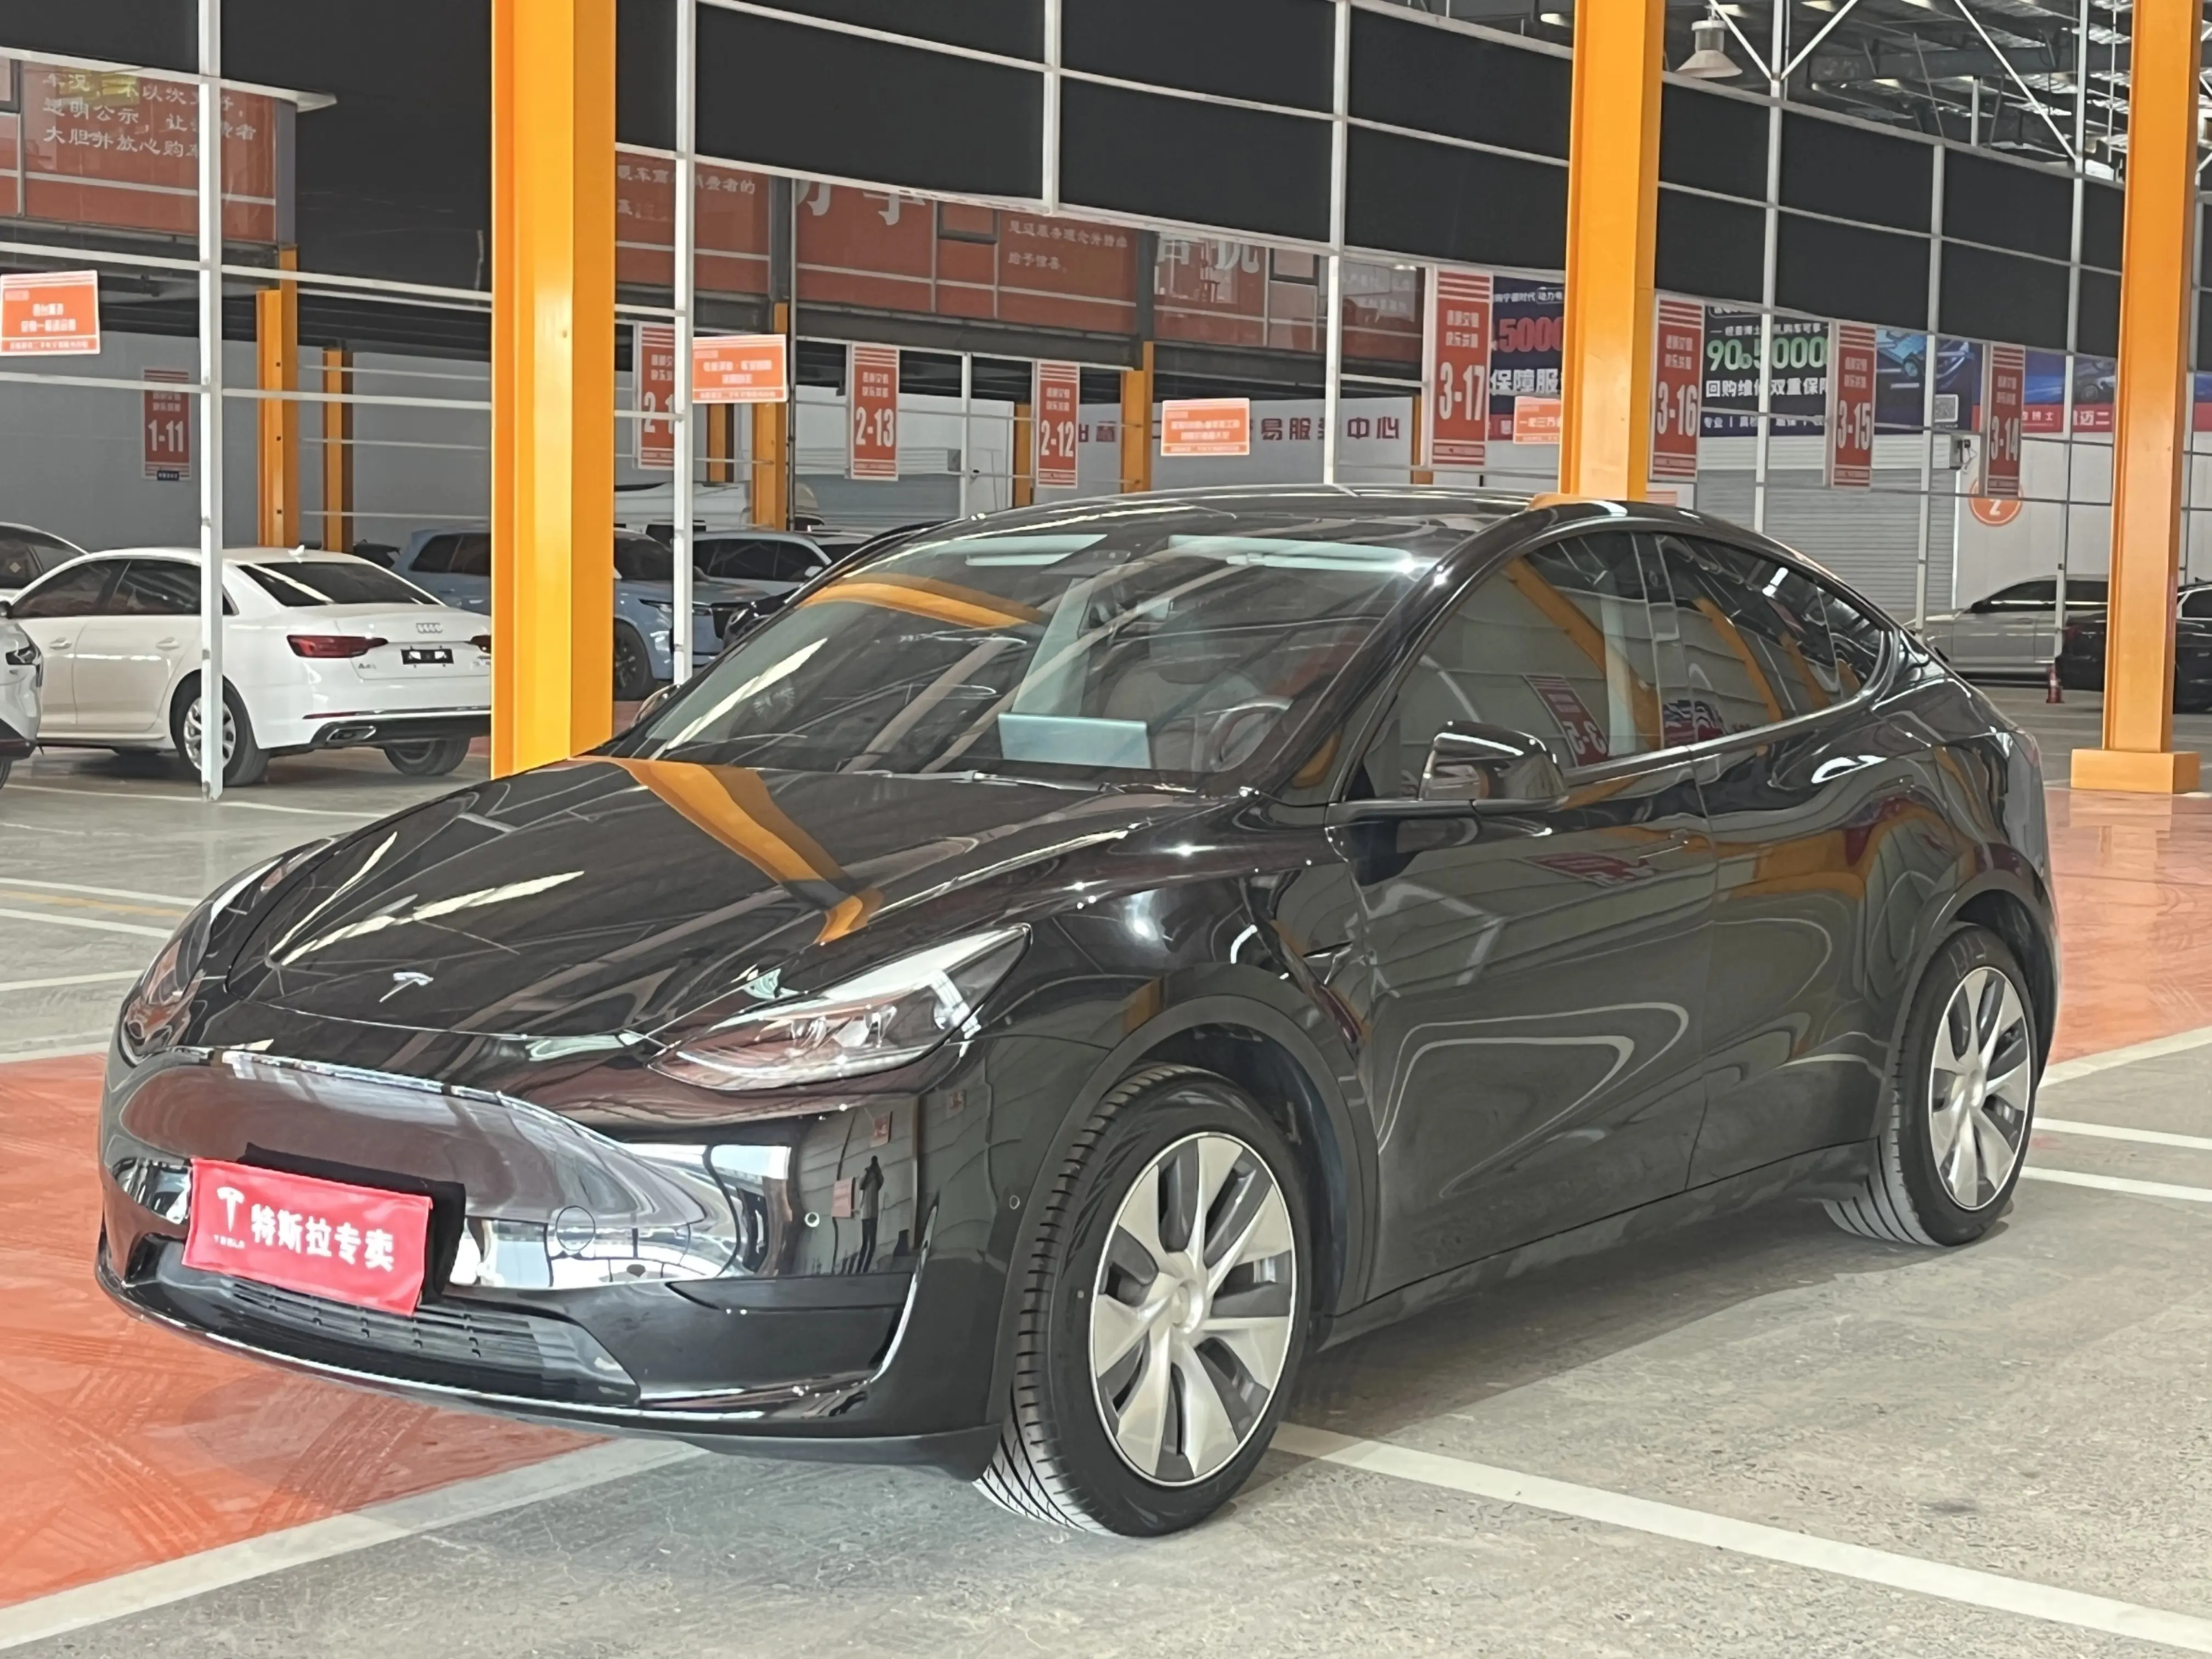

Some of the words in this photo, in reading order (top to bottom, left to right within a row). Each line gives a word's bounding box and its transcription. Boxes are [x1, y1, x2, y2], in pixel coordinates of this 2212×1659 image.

[1438, 362, 1485, 421] 3-17
[1657, 381, 1697, 437] 3-16
[1706, 377, 1827, 398] 回购维双重保
[148, 419, 184, 453] 1-11
[855, 407, 894, 448] 2-13
[1041, 419, 1074, 458] 2-12
[1837, 399, 1871, 450] 3-15
[1990, 415, 2019, 461] 3-14
[251, 1203, 394, 1272] 特斯拉专卖
